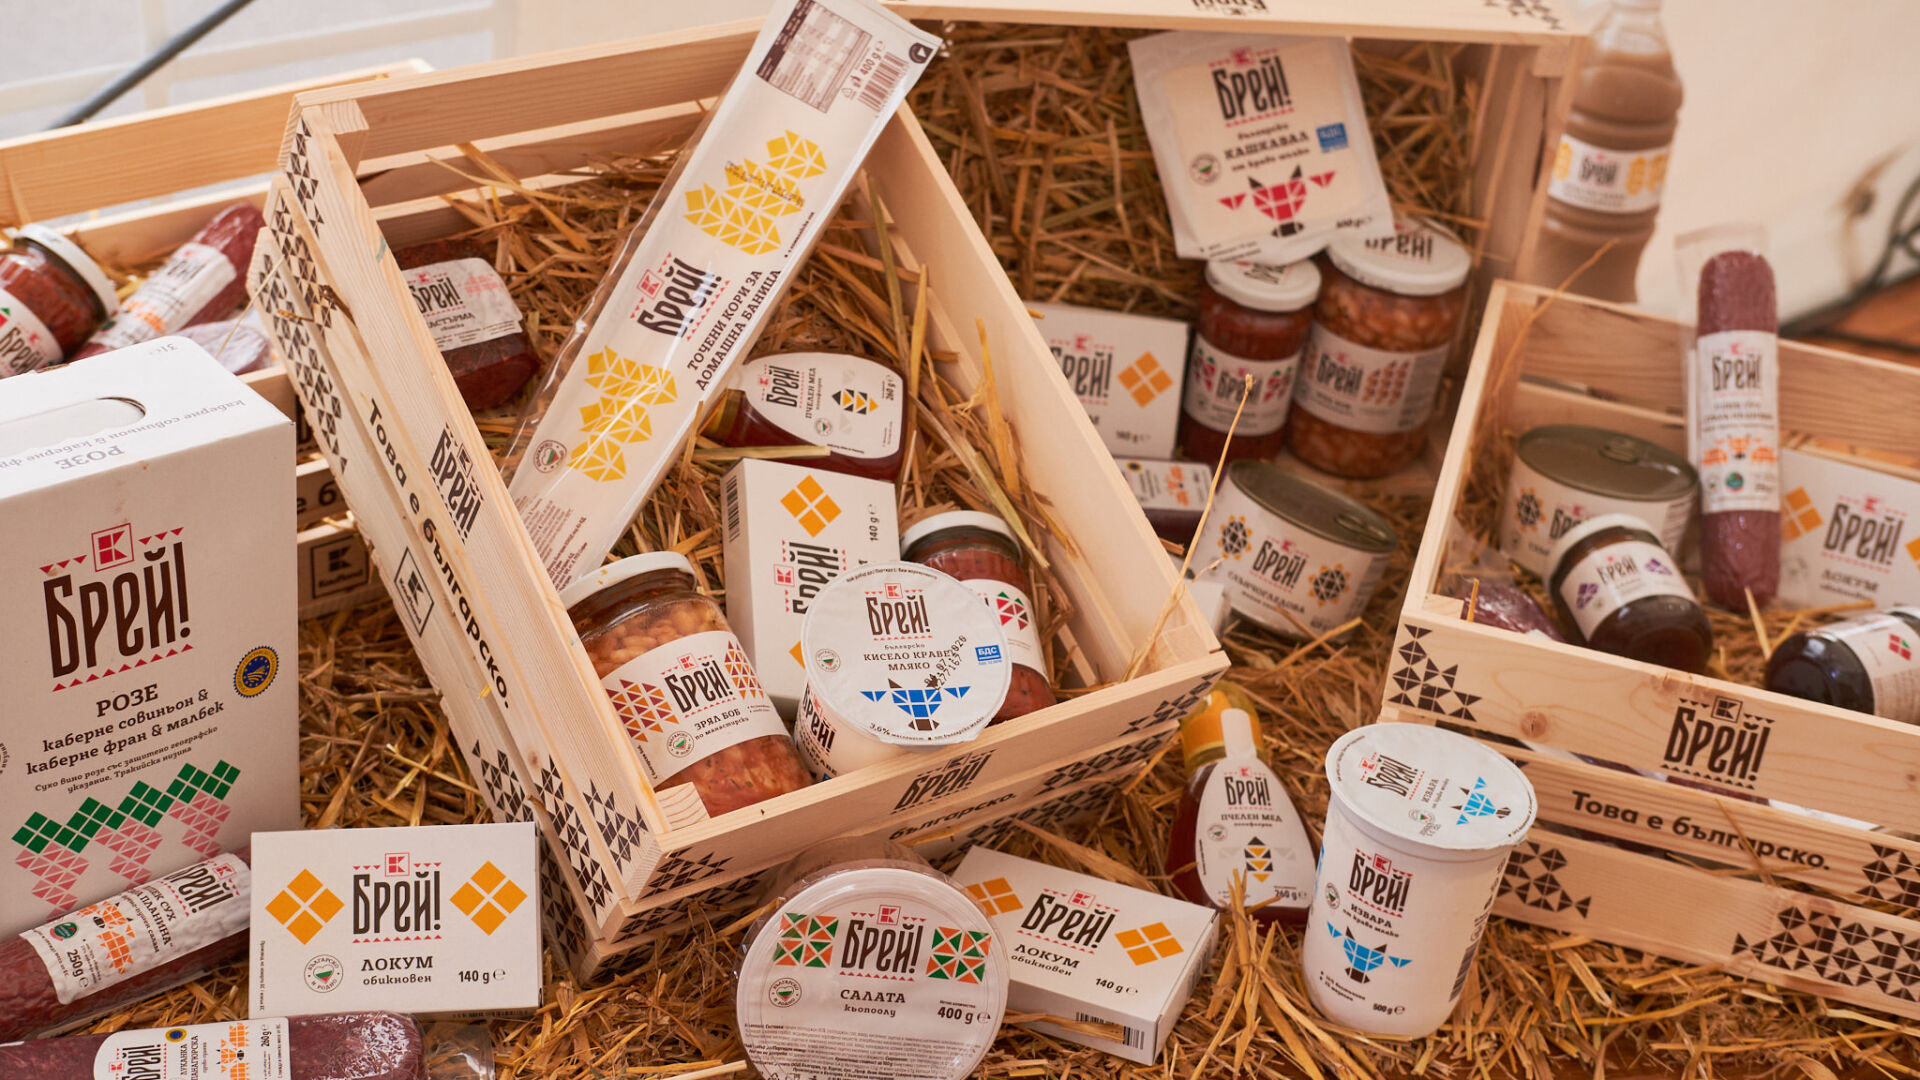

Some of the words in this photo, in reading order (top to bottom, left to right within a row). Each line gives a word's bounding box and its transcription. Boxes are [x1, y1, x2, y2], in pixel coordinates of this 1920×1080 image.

[860, 58, 875, 76] 400
[1212, 56, 1292, 121] Брей!
[1224, 132, 1309, 160] КАШКАВАЛ
[637, 258, 722, 338] Брей!
[430, 312, 476, 329] АСТЪРМА
[687, 320, 726, 372] ТОЧЕНИ
[725, 287, 749, 322] КОРИ
[745, 269, 762, 287] ЗА
[695, 322, 746, 391] ДОМАШНА
[742, 268, 782, 321] БАНИЦА
[766, 365, 800, 408] Брей!
[184, 399, 247, 420] каберне
[805, 385, 816, 419] ПЧЕЛЕН
[98, 436, 108, 446] &
[113, 416, 181, 438] совиньон
[26, 439, 95, 463] каберне
[55, 445, 125, 470] РОЗЕ
[430, 428, 483, 541] Брей!
[869, 525, 879, 542] 140
[1825, 503, 1904, 566] Брей!
[369, 398, 408, 488] Това
[409, 492, 420, 515] е
[422, 518, 509, 709] българско.
[1253, 541, 1307, 590] Брей!
[43, 541, 191, 678] Брей!
[865, 595, 931, 636] Брей!
[863, 651, 911, 661] КИСЕЛО
[913, 650, 951, 660] КРАВЕ
[888, 662, 931, 671] МЛЯКО
[978, 647, 998, 656] БДС
[96, 684, 159, 718] РОЗЕ
[664, 660, 733, 714] Брей!
[43, 724, 115, 752] каберне
[118, 697, 194, 731] совиньон
[198, 688, 209, 702] &
[694, 714, 722, 731] ЗРЯЛ
[723, 708, 741, 722] БОБ
[26, 747, 98, 775] каберне
[103, 731, 147, 758] фран
[151, 724, 163, 738] &
[166, 701, 225, 732] малбек
[695, 733, 704, 741] по
[1663, 706, 1771, 782] Брей!
[60, 774, 83, 787] вино
[85, 768, 105, 783] розе
[124, 746, 170, 767] защитено
[170, 725, 218, 754] географско
[114, 757, 161, 779] Тракийска
[162, 746, 192, 763] низина
[895, 754, 992, 810] Брей!
[1366, 754, 1419, 797] Брей!
[1223, 776, 1271, 806] Брей!
[889, 793, 1017, 841] българско.
[1221, 813, 1259, 822] ПЧЕЛЕН
[1261, 814, 1283, 823] МЕД
[1572, 790, 1639, 824] Това
[1647, 815, 1663, 830] е
[1672, 817, 1830, 871] българско.
[1350, 853, 1411, 912] Брей!
[160, 900, 177, 921] СУХ
[352, 870, 441, 934] Брей!
[1351, 903, 1392, 928] ИЗВАРА
[1021, 893, 1116, 949] Брей!
[148, 928, 161, 952] салам
[841, 919, 924, 974] Брей!
[308, 957, 340, 971] БЪЛГАРСКО
[361, 955, 434, 972] ЛОКУМ
[1011, 955, 1072, 976] обикновен
[1014, 943, 1080, 969] ЛОКУМ
[363, 973, 432, 986] обикновен
[458, 970, 480, 983] 140
[482, 972, 490, 984] g
[1095, 978, 1114, 990] 140
[1115, 984, 1123, 994] g
[840, 989, 906, 1004] САЛАТА
[844, 1005, 896, 1018] кьопоолу
[937, 1006, 962, 1020] 400
[964, 1012, 973, 1024] g
[180, 1043, 188, 1077] ЛУКАНКА
